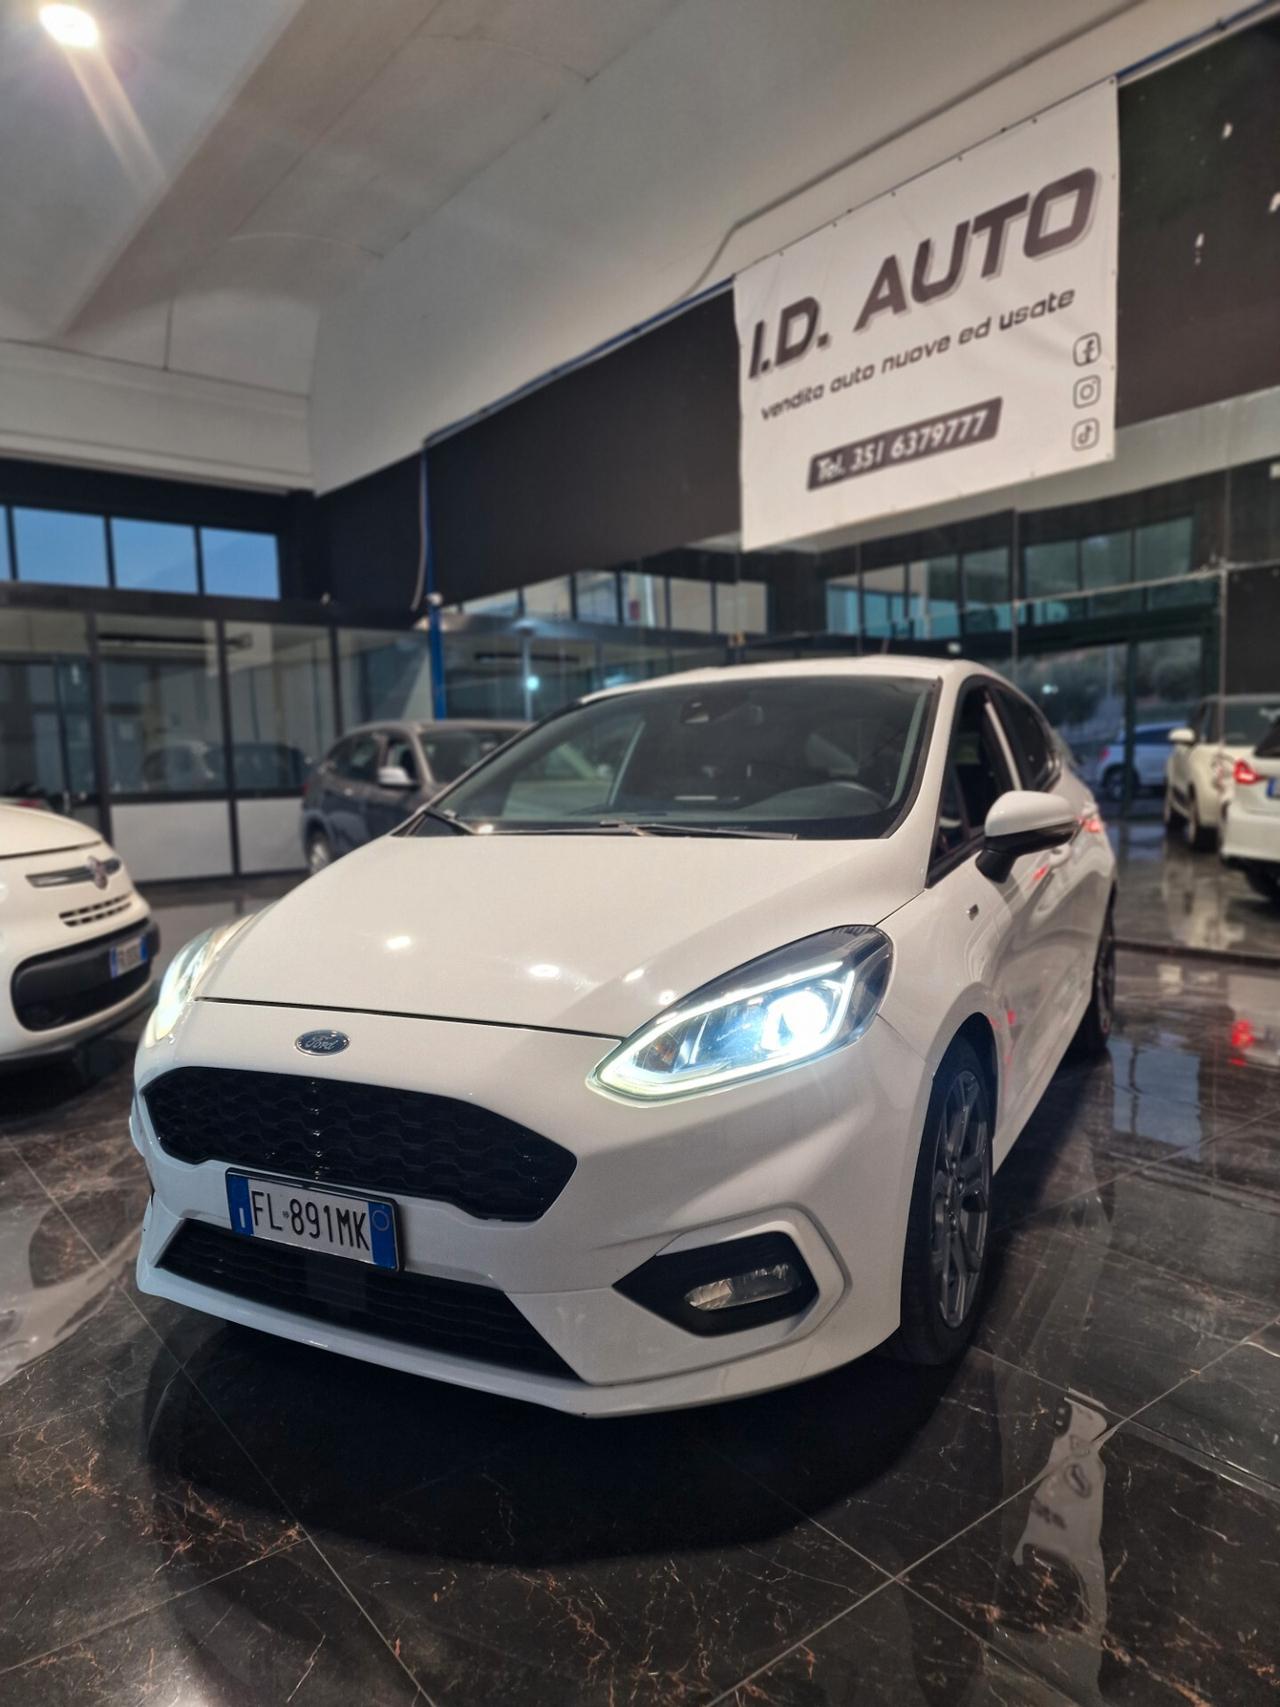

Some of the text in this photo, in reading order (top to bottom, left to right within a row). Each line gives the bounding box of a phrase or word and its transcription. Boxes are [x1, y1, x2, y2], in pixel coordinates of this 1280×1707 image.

[748, 167, 1098, 380] I.D. AUTO
[761, 288, 1075, 421] vendita auto nuove ed usate
[815, 408, 988, 481] Tel. 351 6379777
[304, 1036, 338, 1050] Ford
